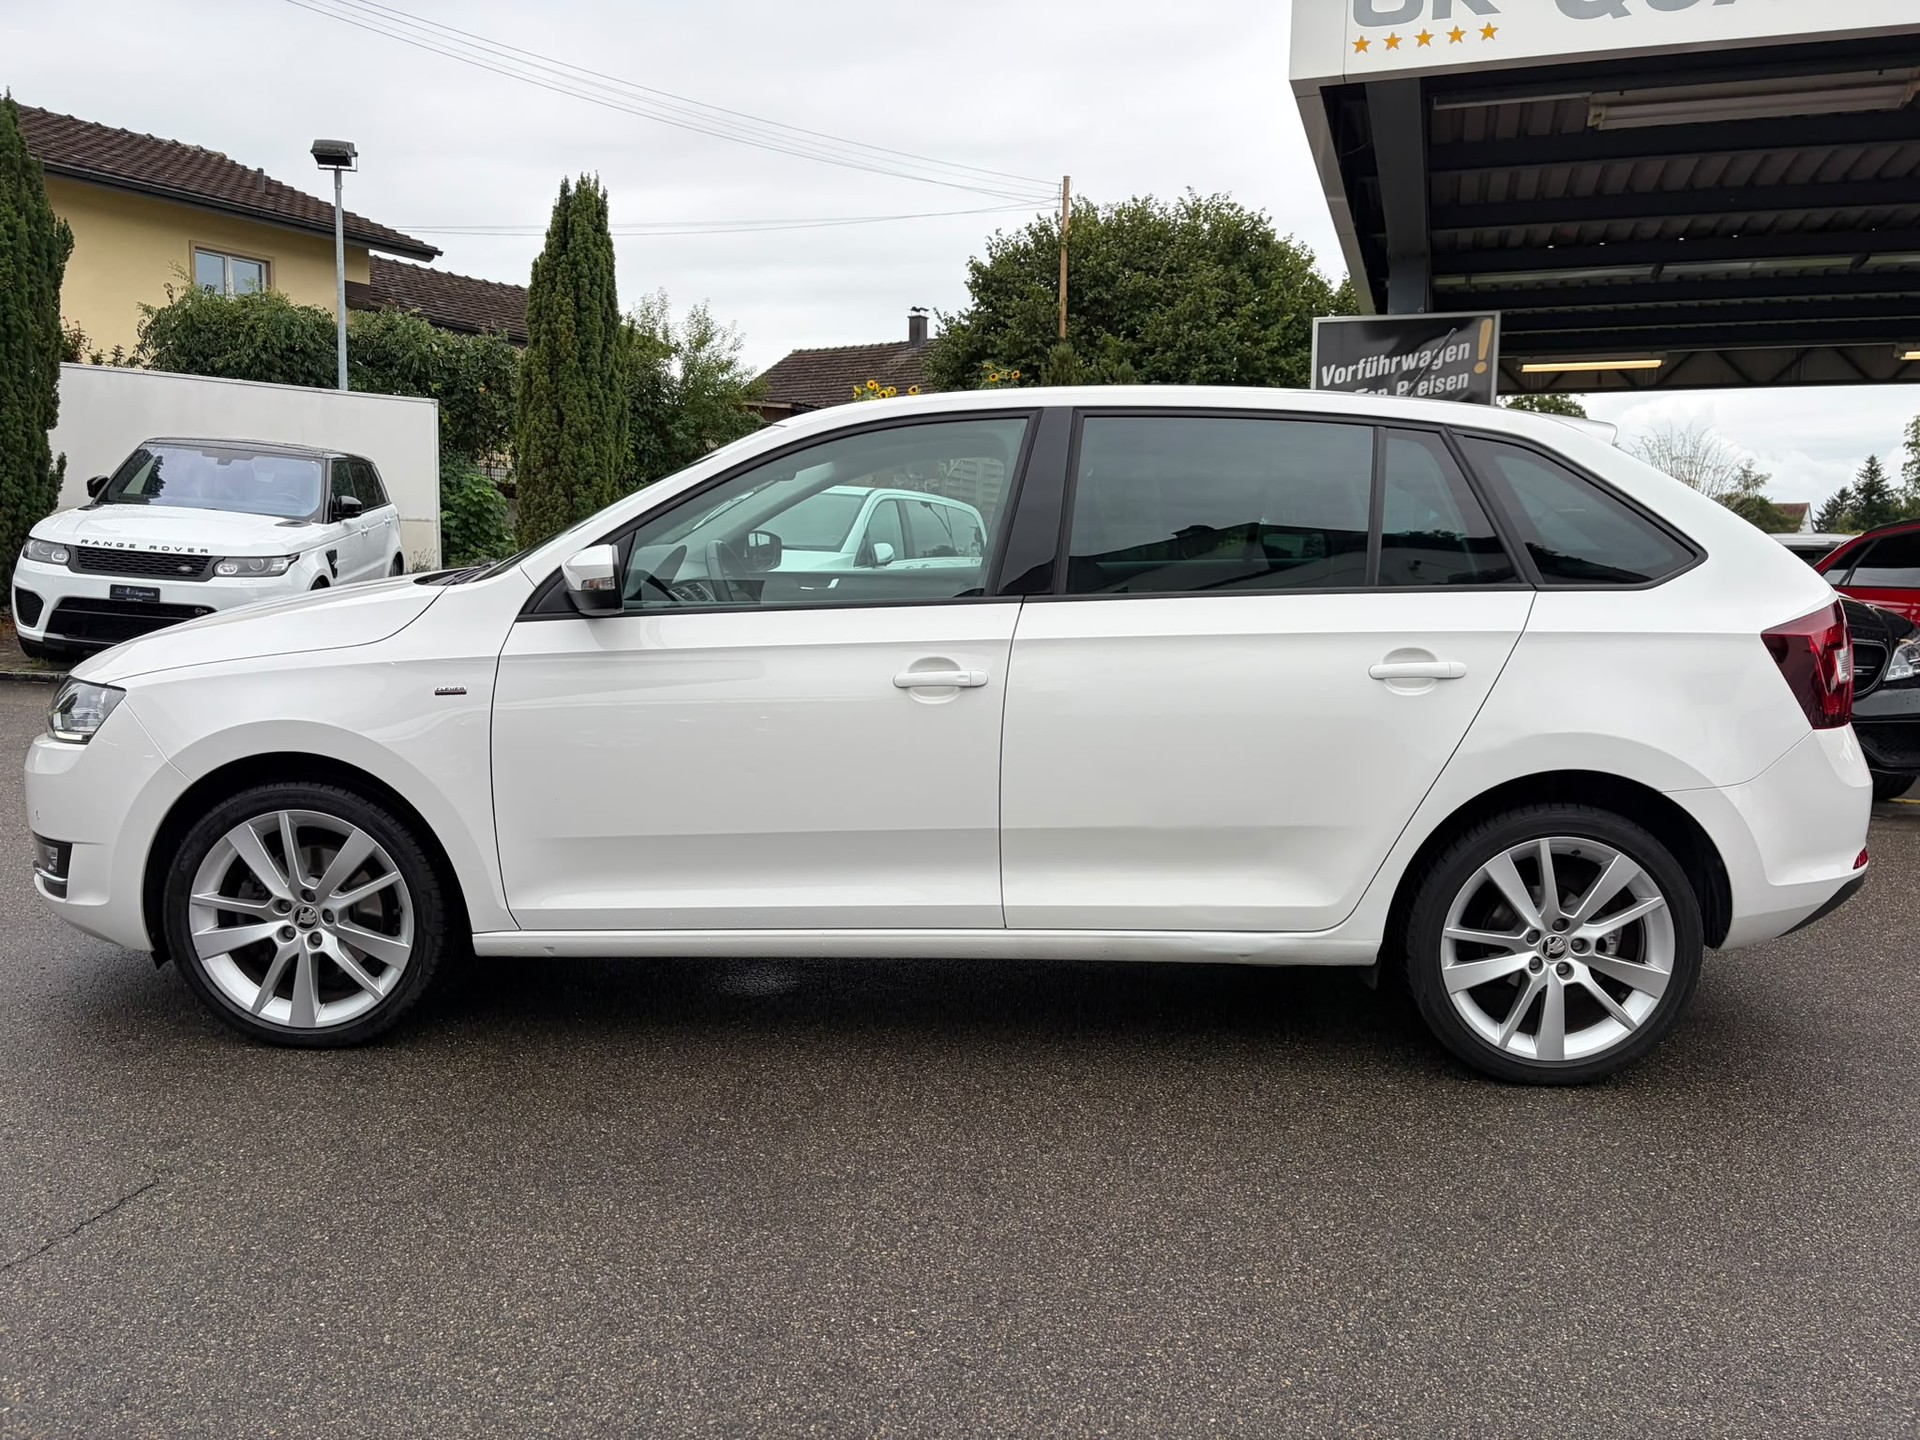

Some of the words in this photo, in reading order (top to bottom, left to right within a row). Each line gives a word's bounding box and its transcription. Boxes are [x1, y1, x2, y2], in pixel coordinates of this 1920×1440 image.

[1321, 342, 1470, 387] Vorführwagen
[80, 539, 137, 549] RANGE
[148, 545, 209, 554] ROVER
